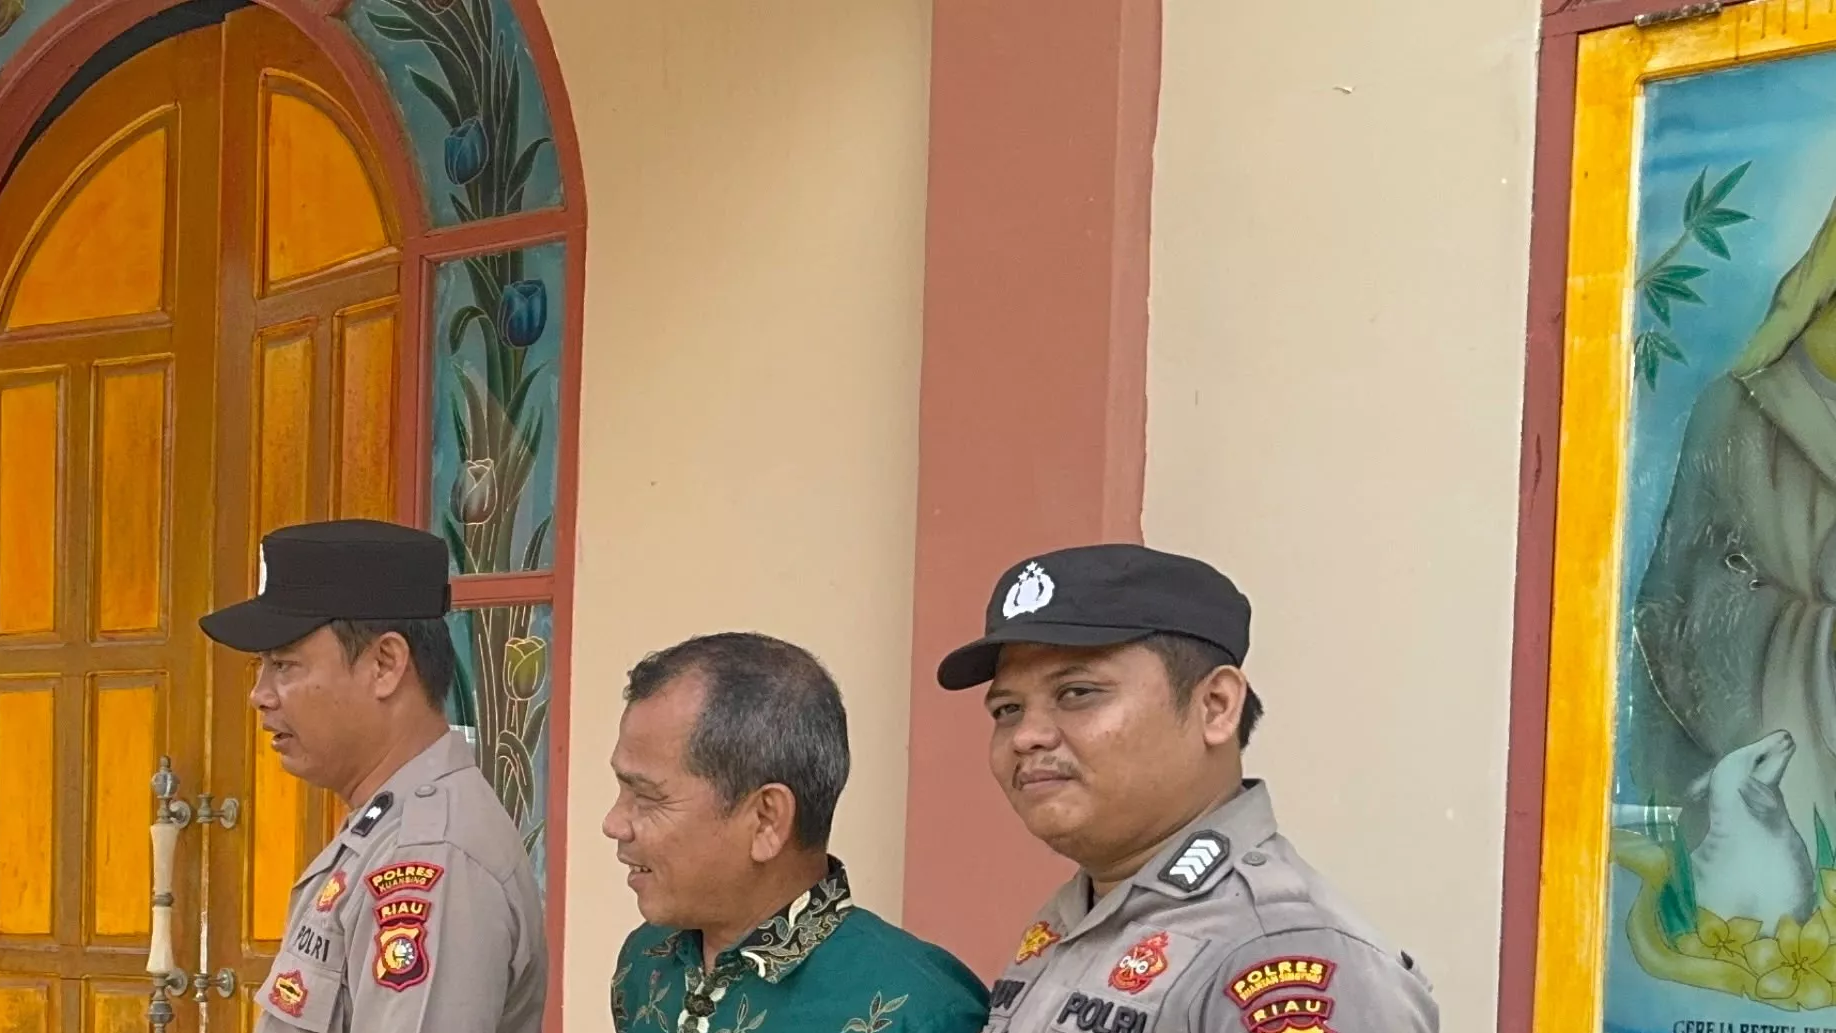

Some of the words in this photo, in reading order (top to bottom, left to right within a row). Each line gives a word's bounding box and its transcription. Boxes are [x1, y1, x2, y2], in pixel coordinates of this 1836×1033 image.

[372, 866, 435, 887] POLRES
[381, 902, 423, 917] RIAU
[293, 925, 330, 963] POLRI
[1233, 961, 1324, 993] POLRES
[1252, 999, 1321, 1022] RIAU
